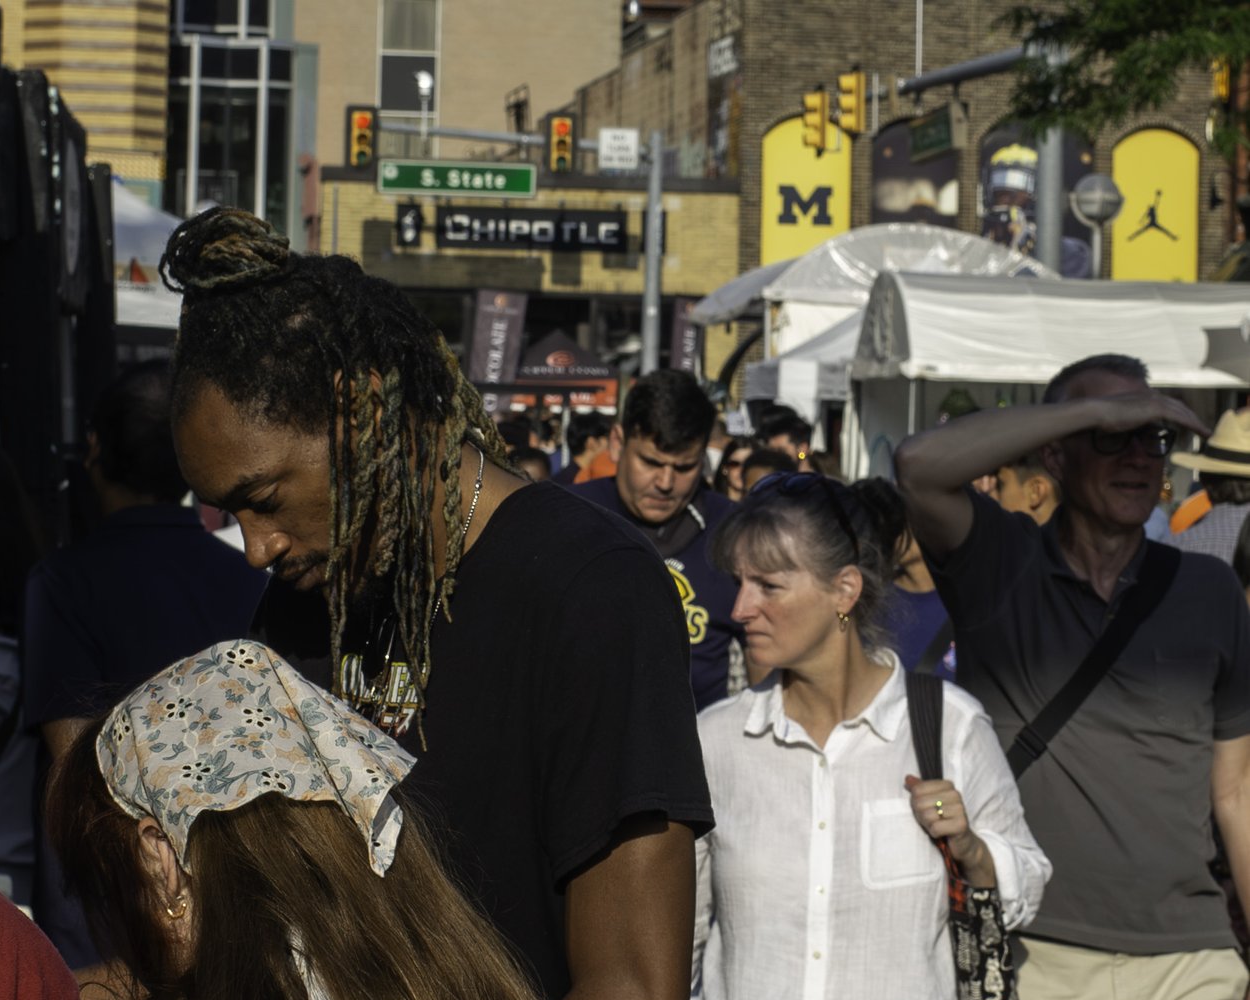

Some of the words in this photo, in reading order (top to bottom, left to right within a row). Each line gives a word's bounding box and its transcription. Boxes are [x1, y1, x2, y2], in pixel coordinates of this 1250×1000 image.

[447, 169, 507, 189] State
[778, 185, 833, 226] M
[445, 214, 620, 245] CHIPOTLE
